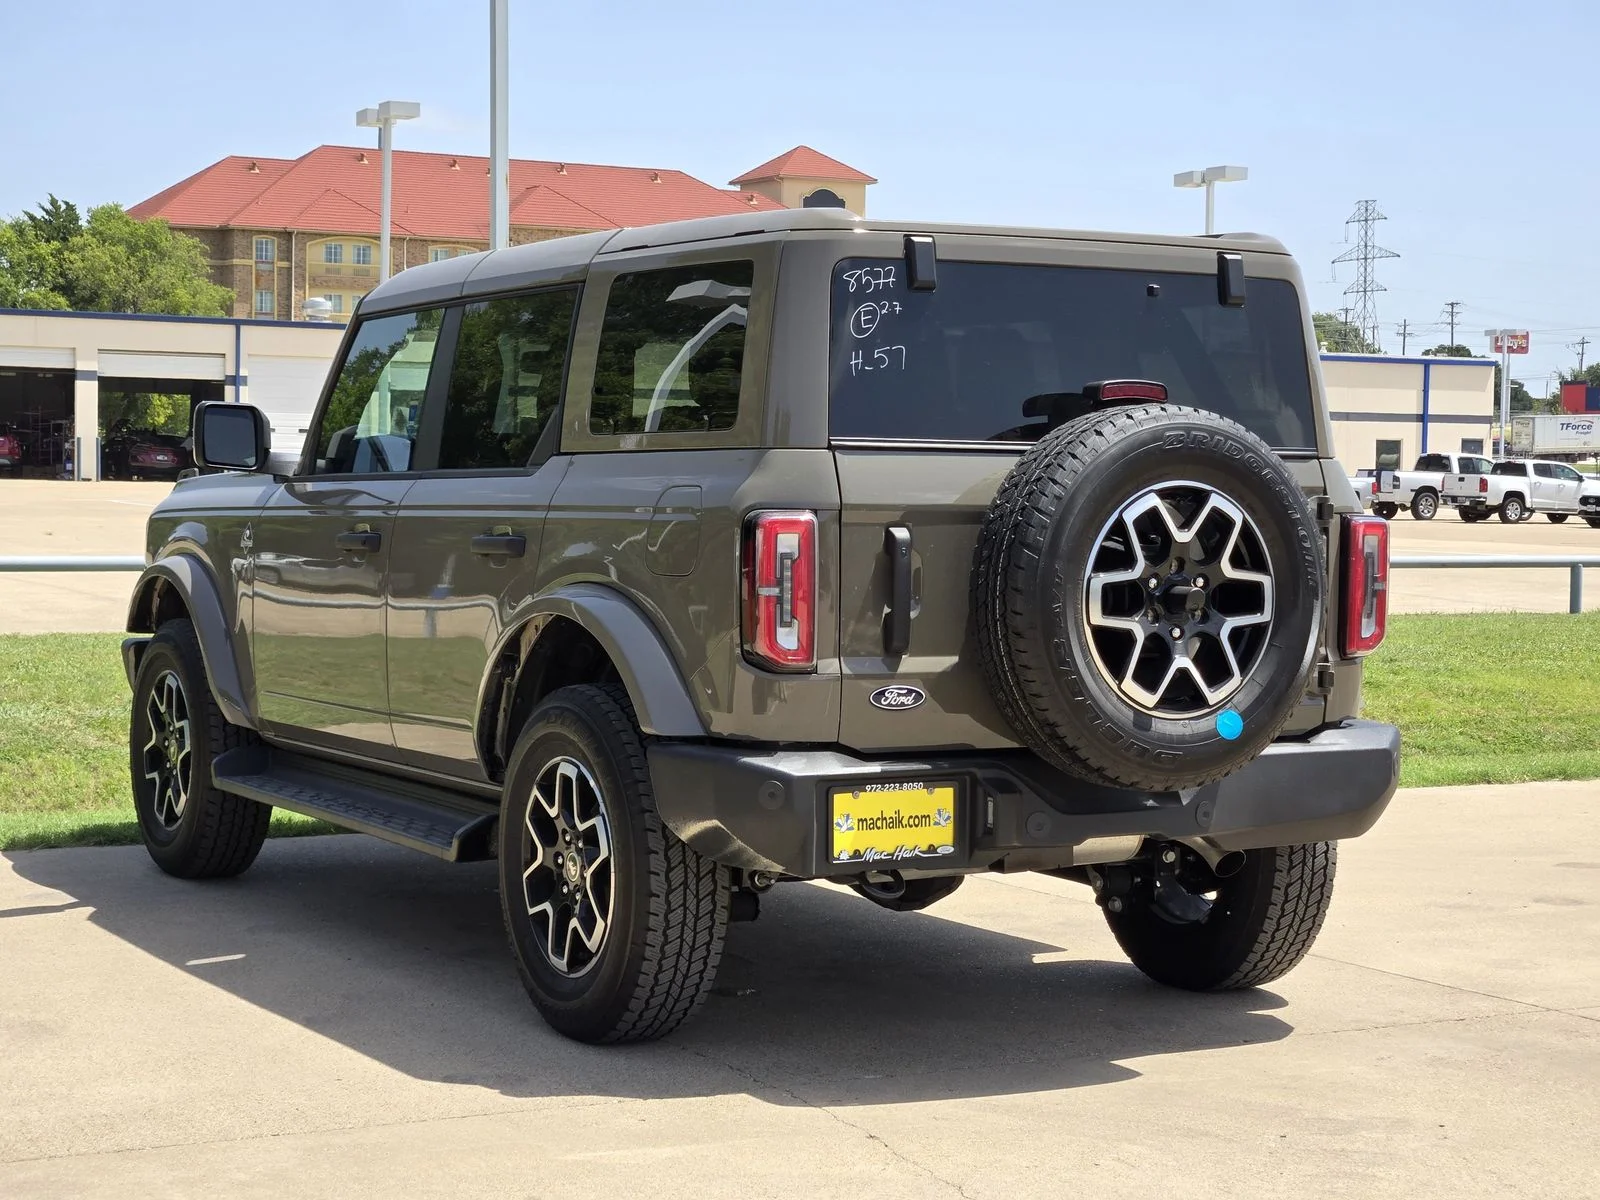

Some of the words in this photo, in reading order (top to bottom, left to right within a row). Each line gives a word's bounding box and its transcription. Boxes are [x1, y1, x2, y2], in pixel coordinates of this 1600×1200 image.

[842, 266, 896, 293] 8577
[860, 306, 874, 329] E
[1496, 335, 1527, 350] Lby's
[1560, 422, 1593, 431] TForce
[1163, 430, 1318, 586] BRIDGESTONE
[881, 688, 916, 706] Ford
[865, 782, 924, 793] 972-223-8050
[857, 809, 931, 831] machaik.com
[861, 846, 893, 863] Mac
[892, 844, 922, 861] Haik
